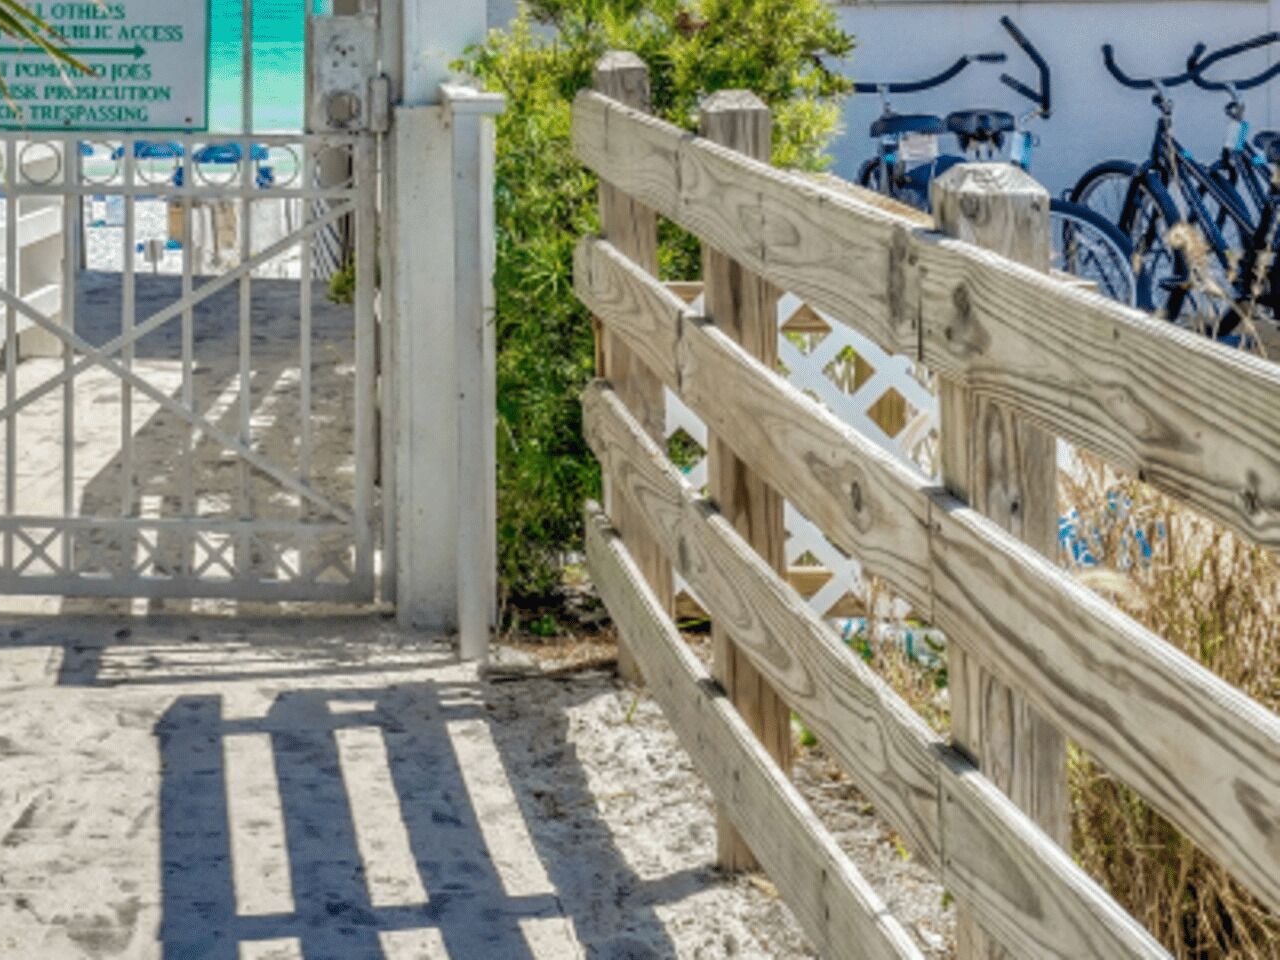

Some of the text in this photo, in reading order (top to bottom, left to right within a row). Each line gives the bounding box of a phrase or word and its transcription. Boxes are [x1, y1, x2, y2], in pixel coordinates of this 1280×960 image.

[118, 24, 184, 42] ACCESS
[43, 85, 172, 101] PROSECUTION
[30, 104, 149, 122] TRESPASSING
